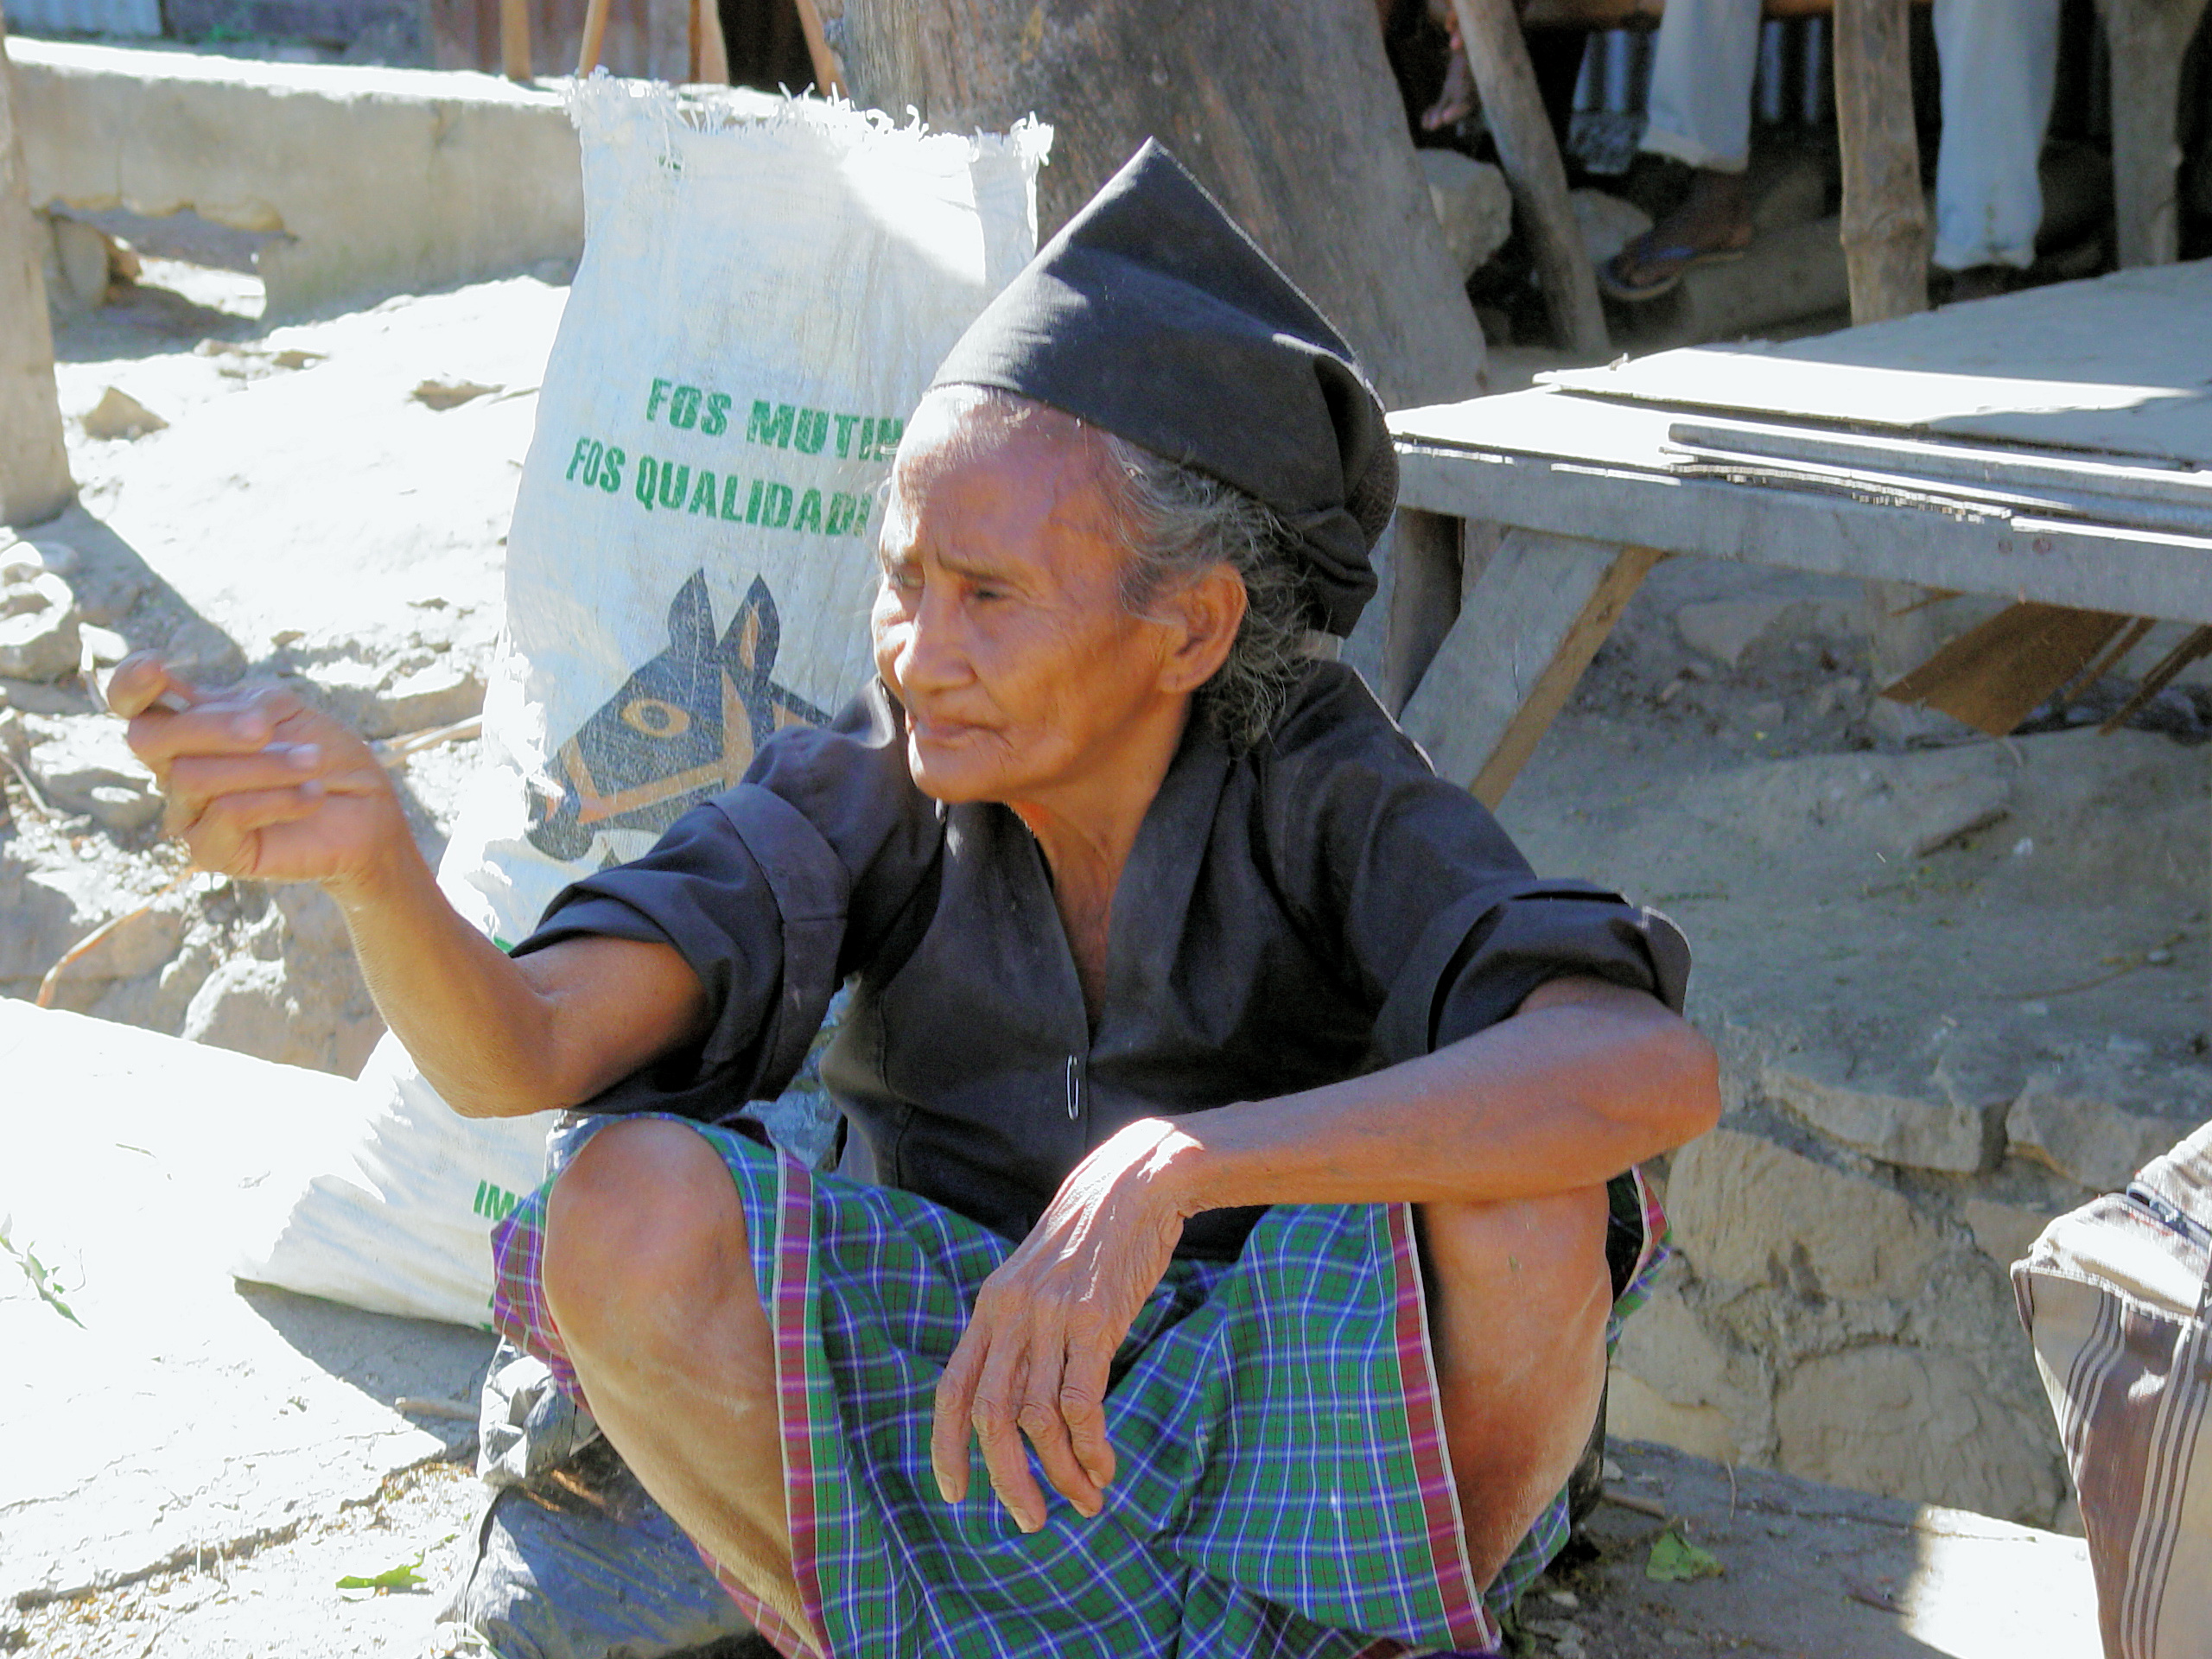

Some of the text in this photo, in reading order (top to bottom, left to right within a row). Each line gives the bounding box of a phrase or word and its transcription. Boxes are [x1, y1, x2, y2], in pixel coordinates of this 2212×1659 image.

[645, 377, 733, 437] FOS
[565, 436, 626, 494] FOS
[473, 1179, 522, 1222] IM
